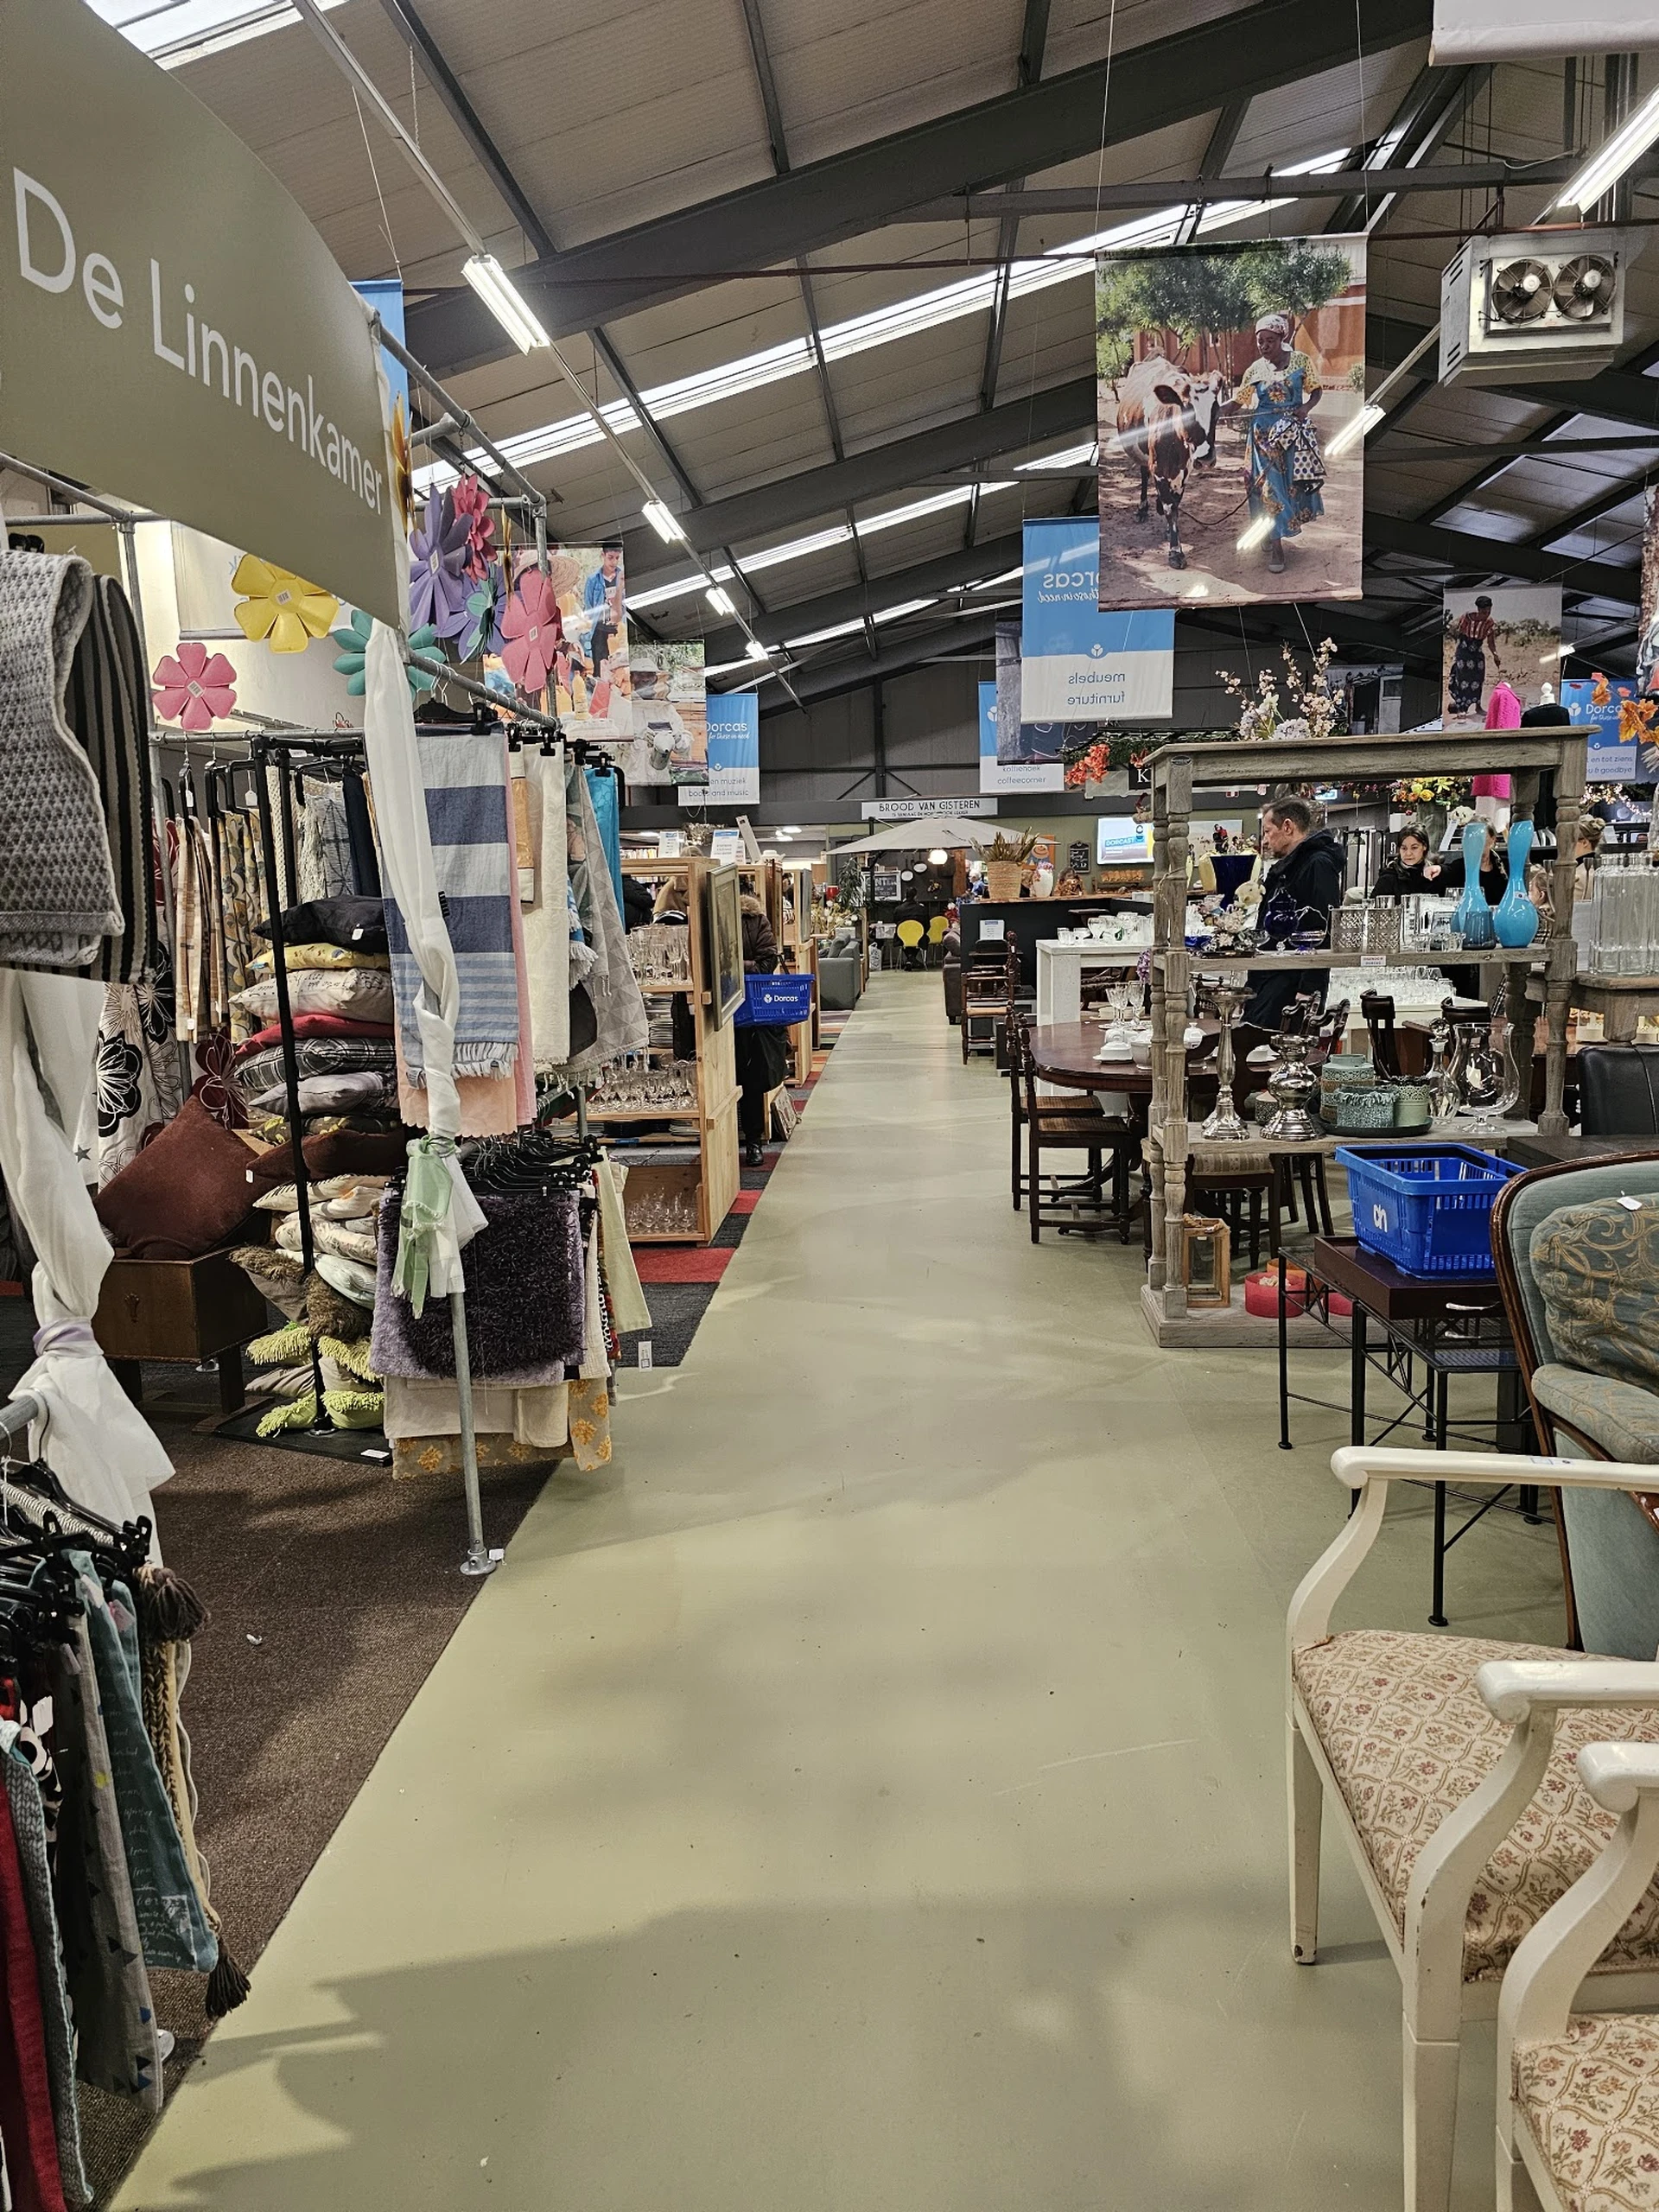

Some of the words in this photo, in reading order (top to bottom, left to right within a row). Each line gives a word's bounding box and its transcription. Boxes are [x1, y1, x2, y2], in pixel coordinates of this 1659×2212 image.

[13, 166, 124, 330] De
[150, 258, 382, 515] Linnenkamer
[997, 776, 1046, 785] coffeecorner
[879, 803, 914, 812] BROOD
[918, 801, 935, 810] VAN
[939, 800, 980, 810] GISTEREN
